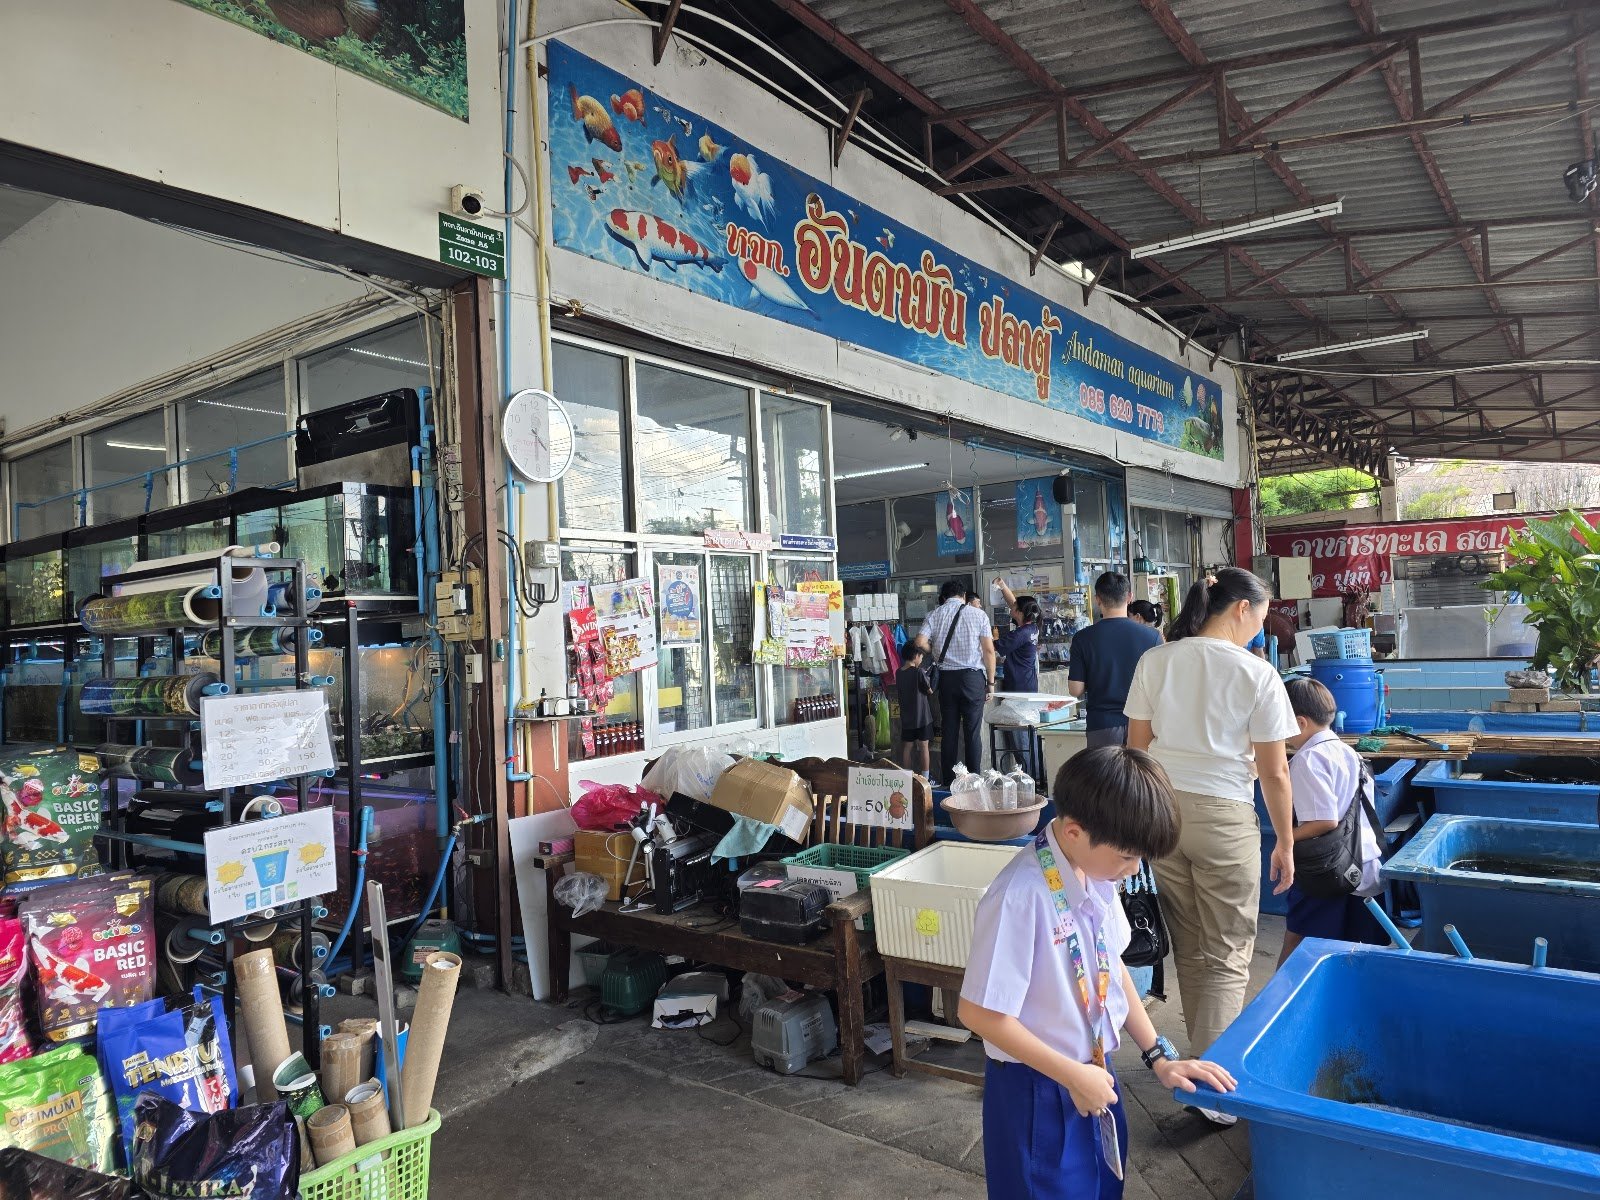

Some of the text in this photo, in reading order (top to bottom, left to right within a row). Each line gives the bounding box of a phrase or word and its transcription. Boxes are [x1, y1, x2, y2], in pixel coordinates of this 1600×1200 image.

[455, 233, 476, 245] Zone
[448, 247, 497, 271] 102-103
[725, 192, 1063, 402] หจก. อันดามัน ปลาตู้
[1062, 331, 1175, 400] Andaman aquarium
[1079, 382, 1165, 434] 085 620 7773
[1291, 530, 1448, 559] อาหารทะเล
[1457, 525, 1507, 551] สด!
[52, 799, 99, 813] BASIC
[865, 799, 884, 813] 50
[57, 812, 100, 825] GREEN
[93, 940, 145, 962] BASIC
[116, 955, 146, 971] RED
